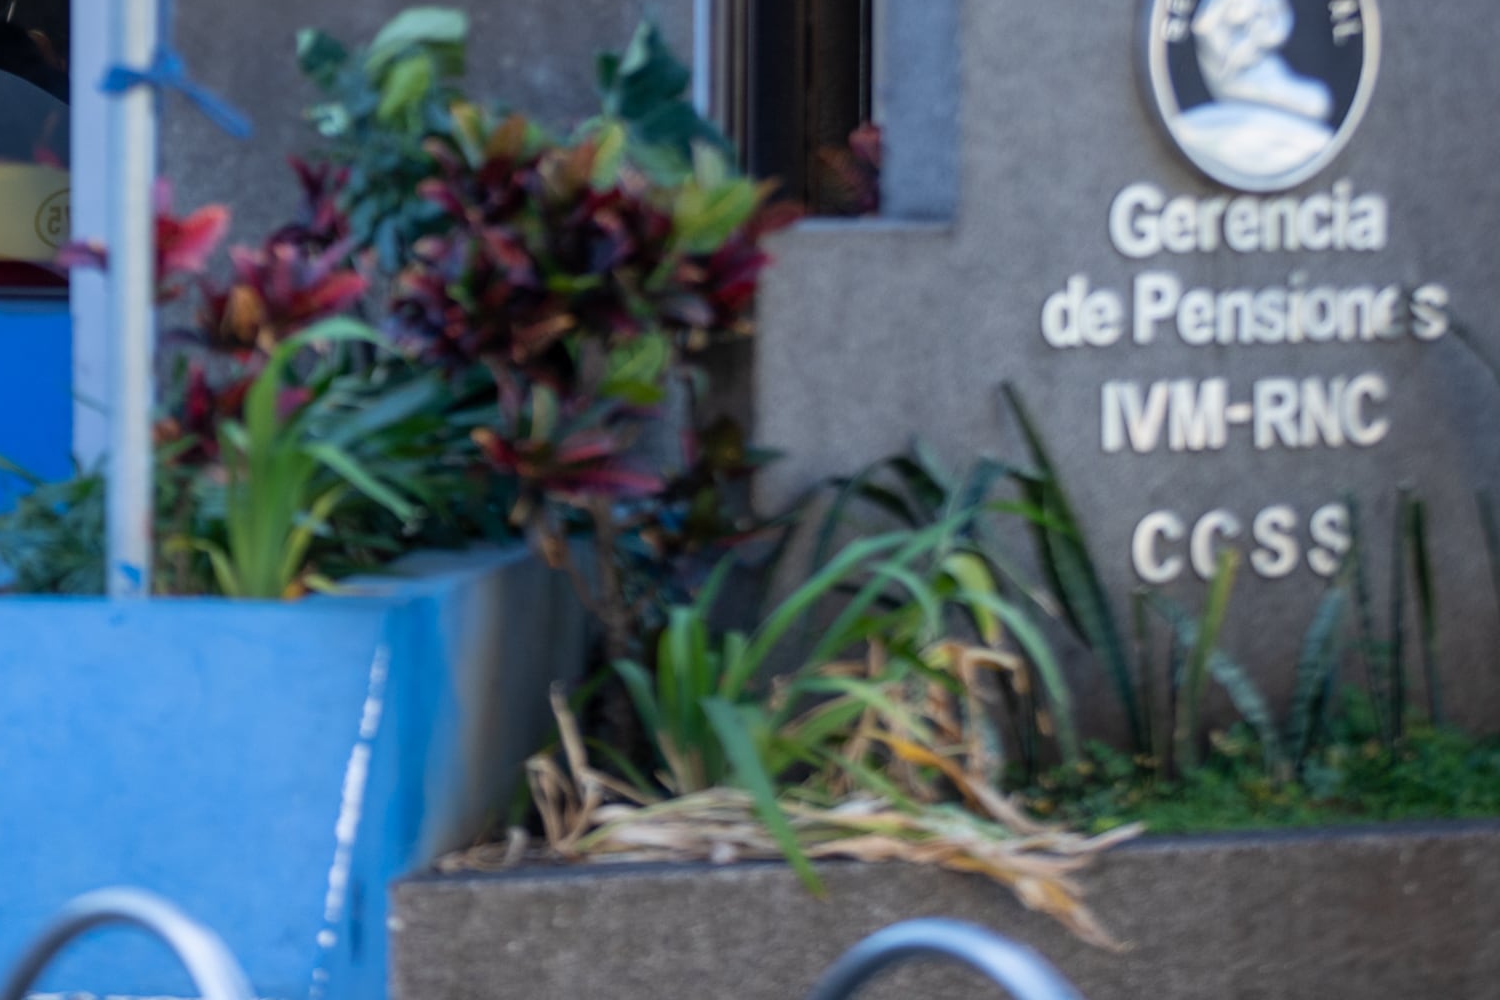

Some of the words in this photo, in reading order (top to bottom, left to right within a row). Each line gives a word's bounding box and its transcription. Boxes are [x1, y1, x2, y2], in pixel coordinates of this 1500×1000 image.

[1109, 178, 1388, 258] Gerencia
[1041, 273, 1123, 348] de
[1101, 372, 1391, 453] IVM-RNC
[1132, 504, 1353, 583] CCSS
